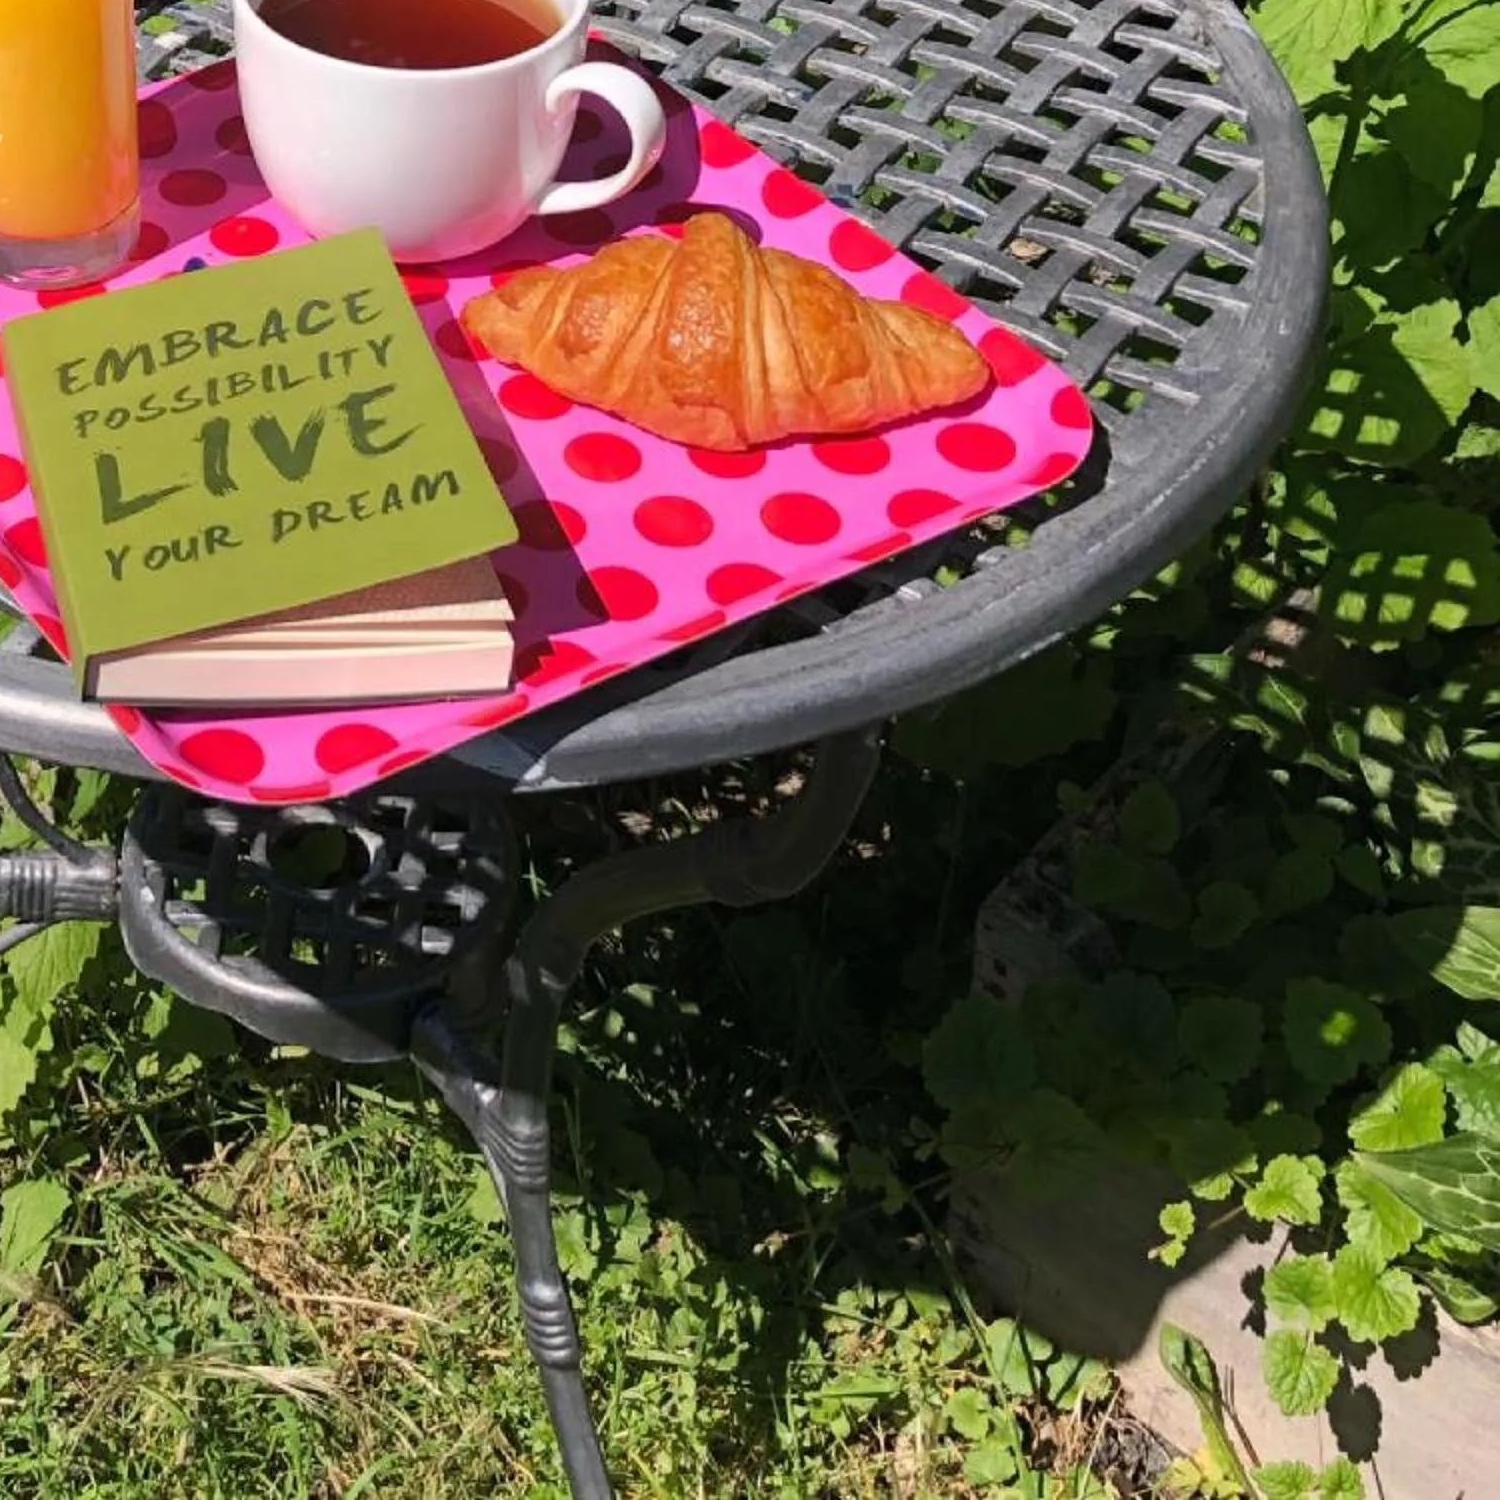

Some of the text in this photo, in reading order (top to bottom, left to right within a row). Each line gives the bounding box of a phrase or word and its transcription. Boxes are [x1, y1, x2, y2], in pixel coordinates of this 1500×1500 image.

[56, 288, 382, 396] EMBRACE
[74, 335, 394, 438] POSSIBILITY
[94, 384, 426, 525] LIVE
[105, 469, 460, 581] YOUR DREAM
